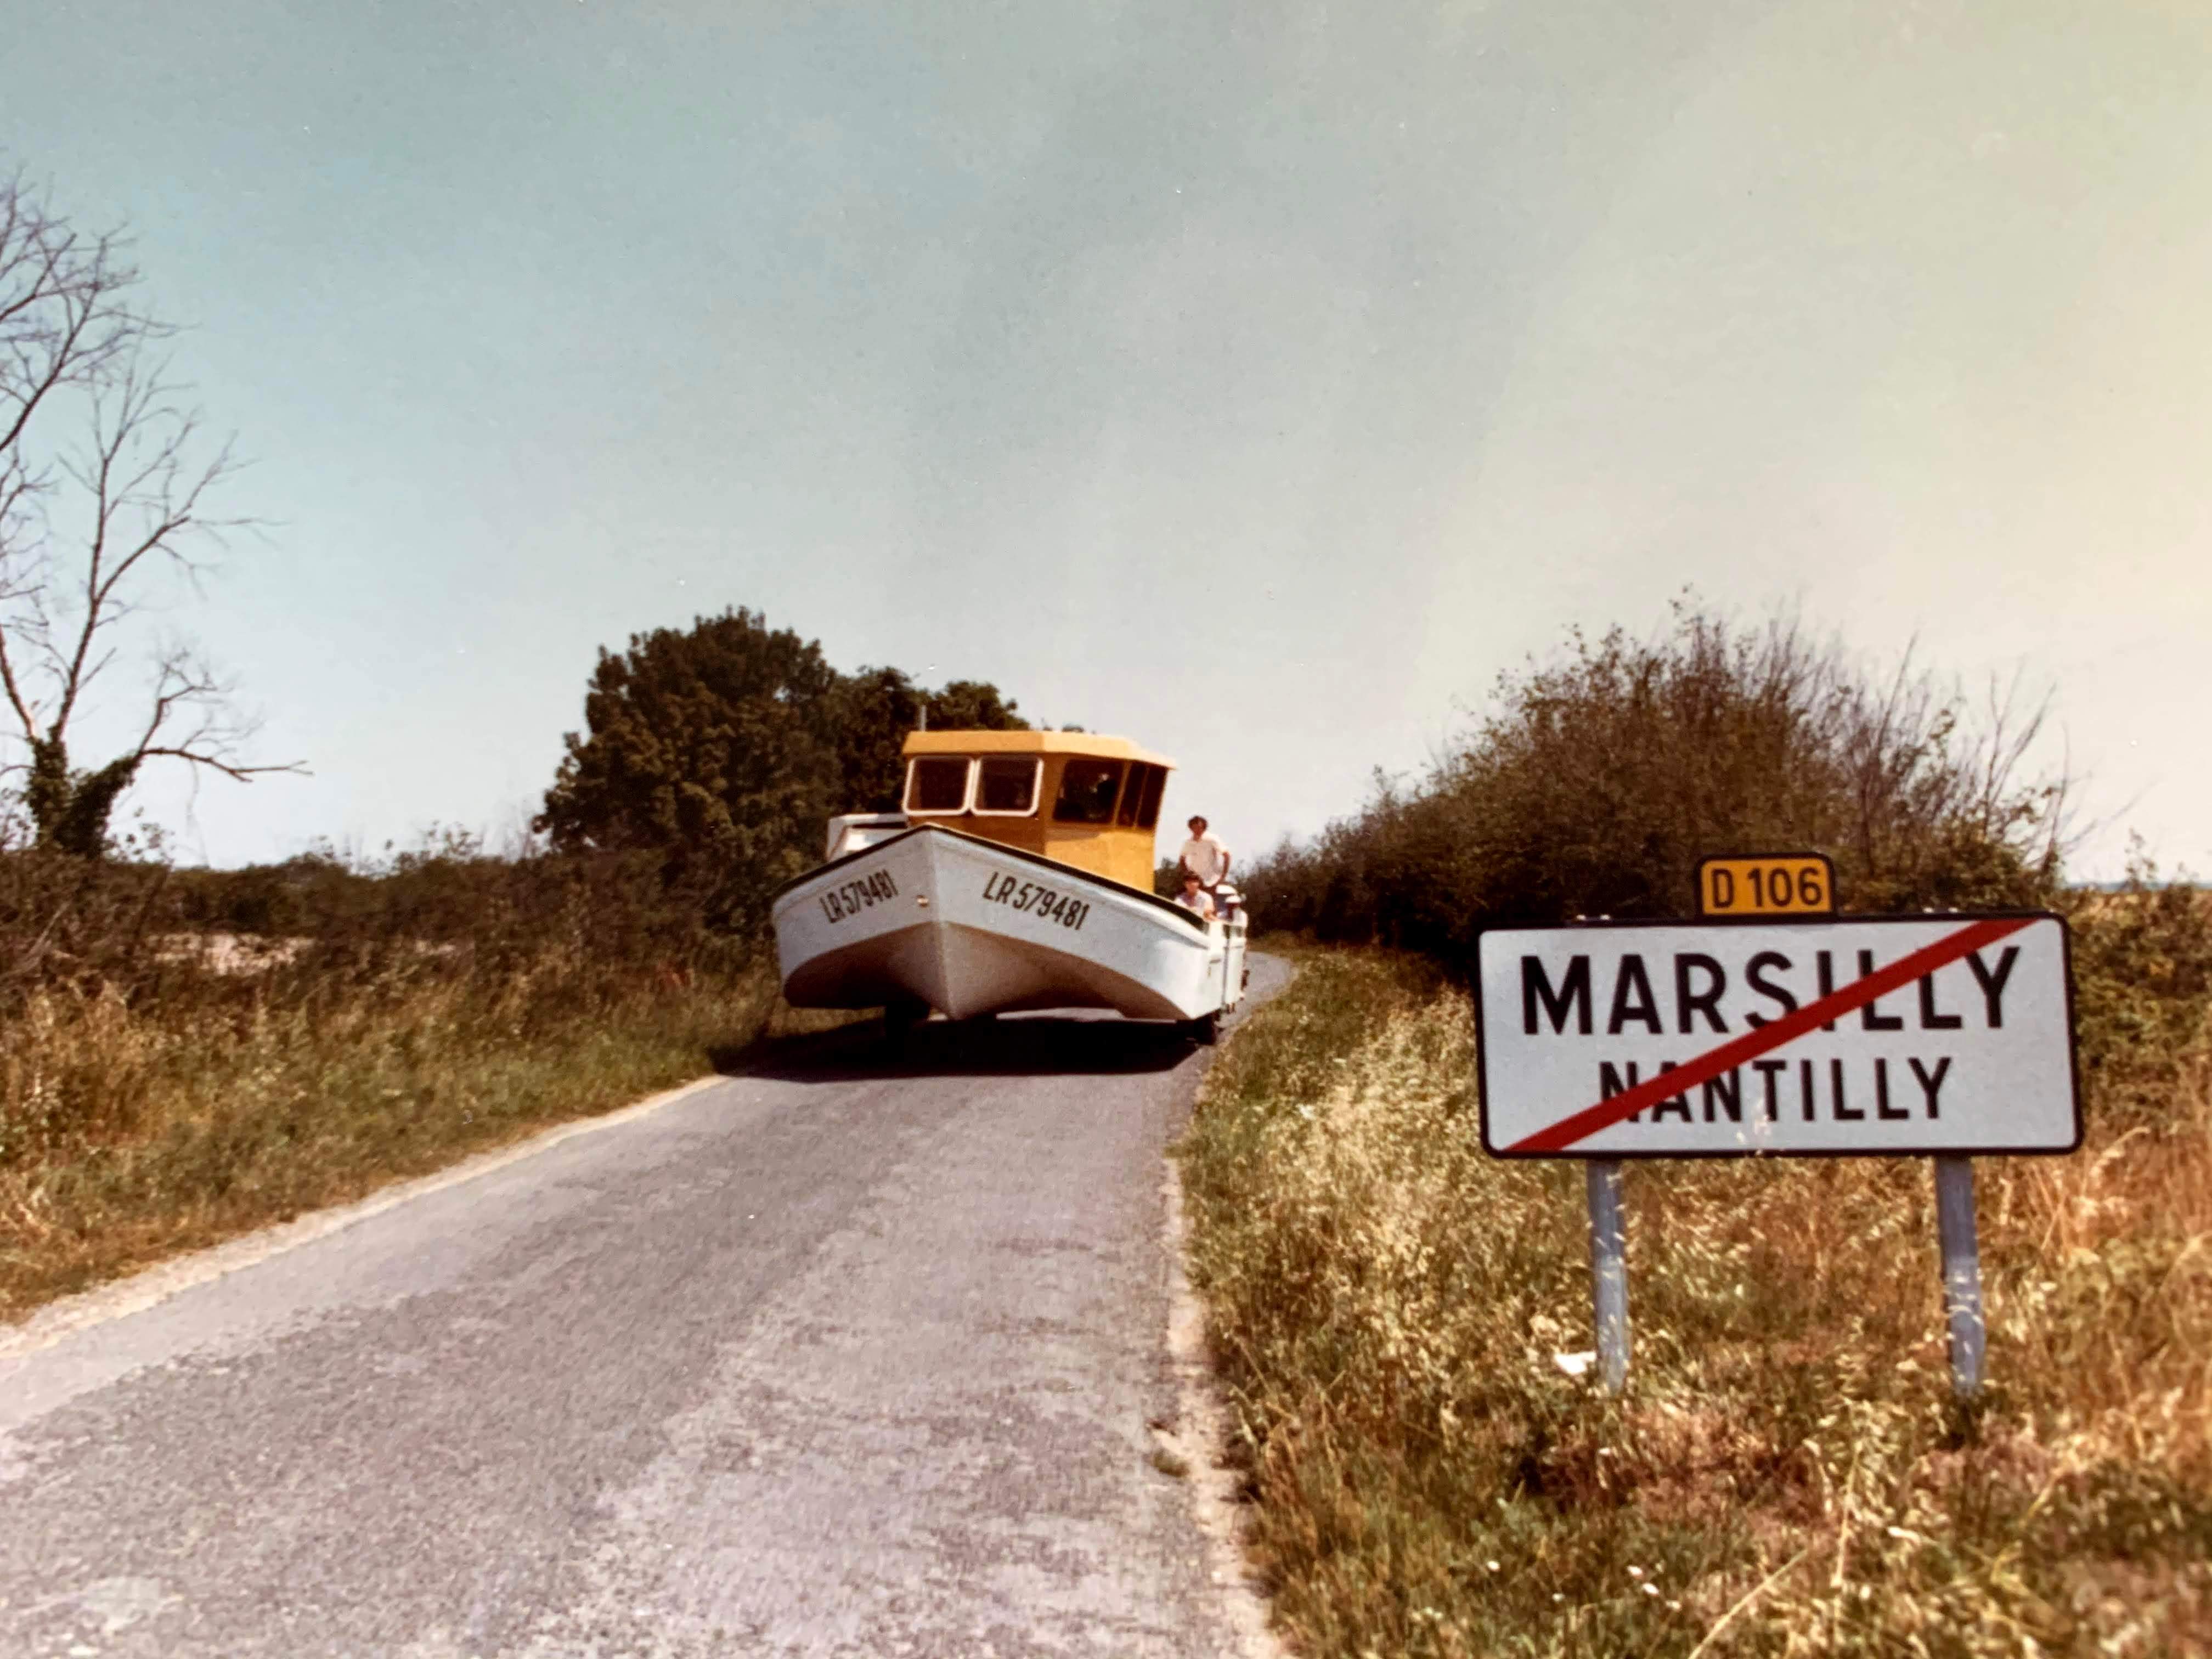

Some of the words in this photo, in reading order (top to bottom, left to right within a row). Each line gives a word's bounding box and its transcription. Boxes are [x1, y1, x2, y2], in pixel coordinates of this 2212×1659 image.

[1710, 867, 1737, 910] D
[1746, 866, 1824, 909] 106
[1520, 945, 2020, 1035] MARSILLY
